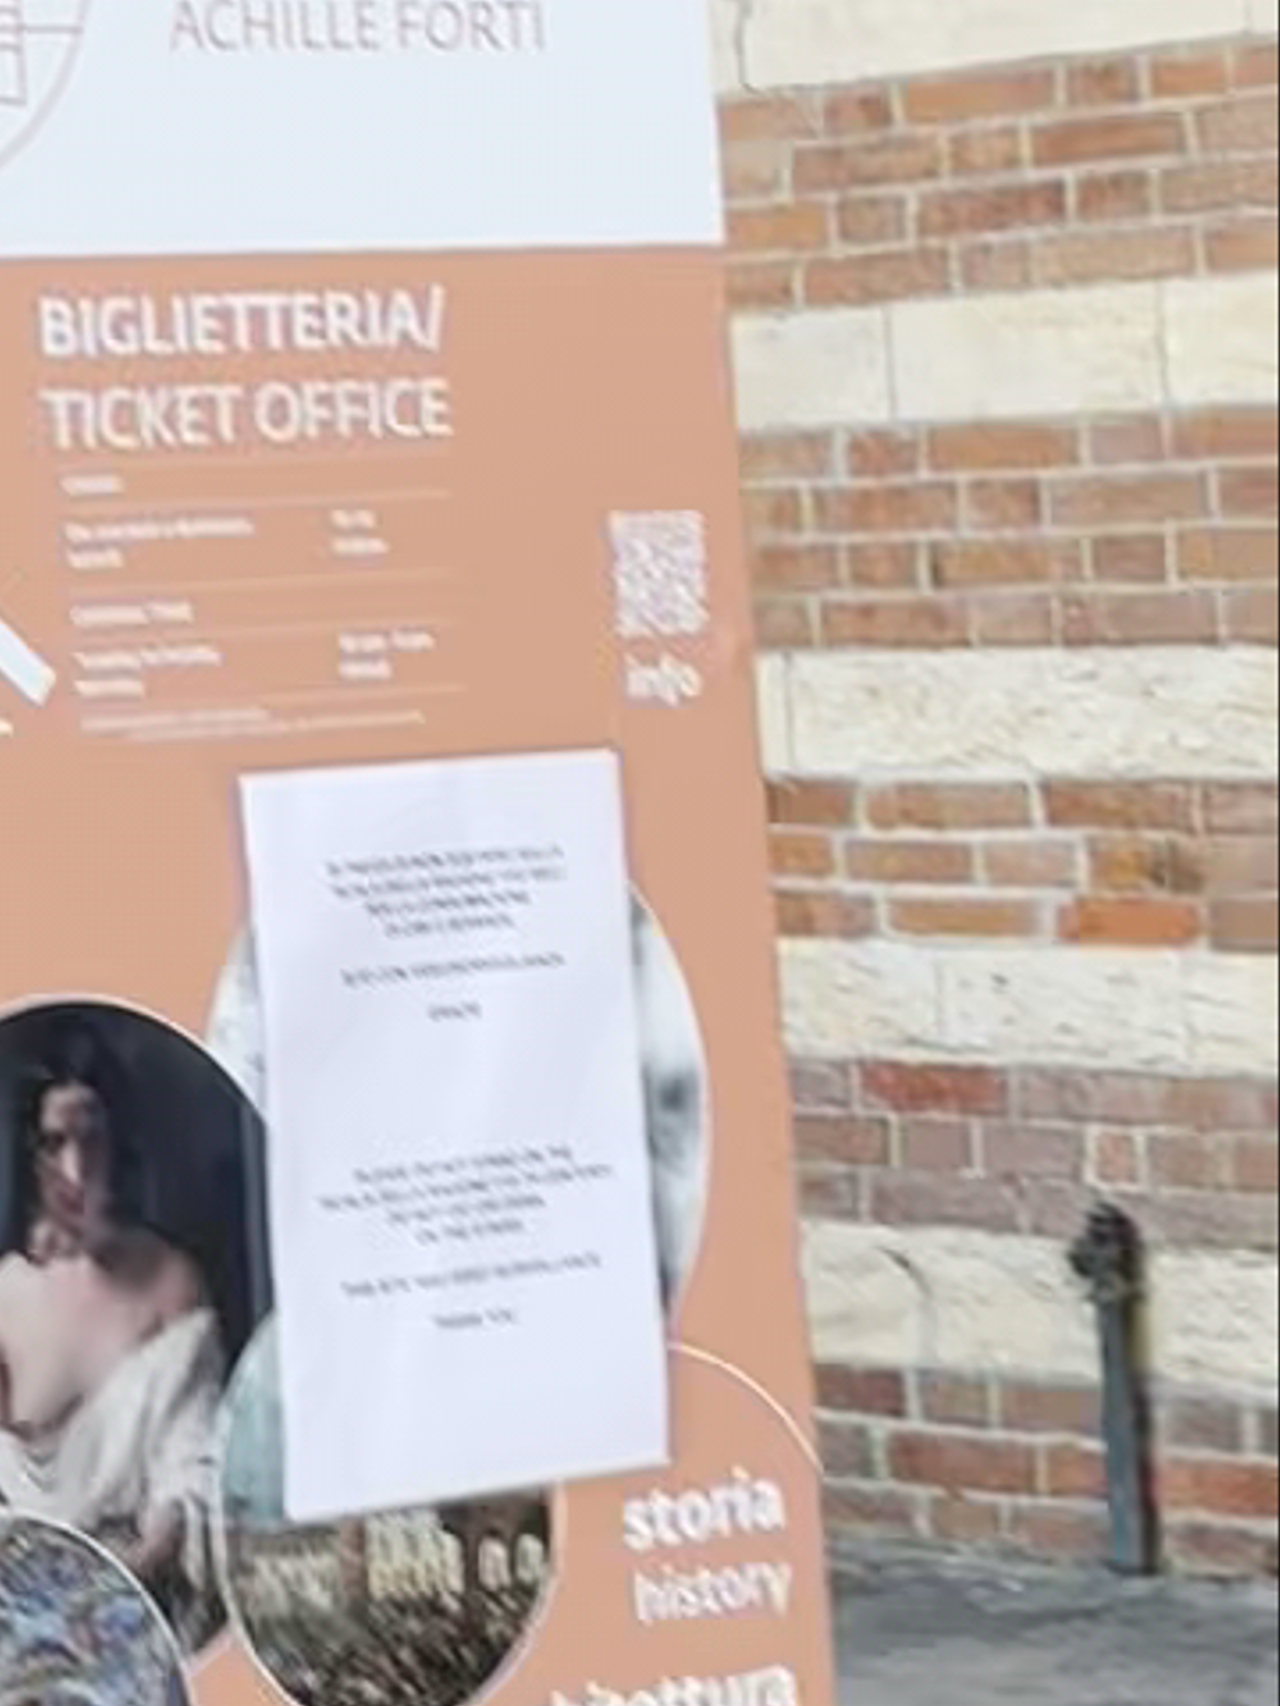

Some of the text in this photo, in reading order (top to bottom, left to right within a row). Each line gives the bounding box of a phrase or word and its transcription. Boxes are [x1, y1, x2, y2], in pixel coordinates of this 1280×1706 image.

[393, 0, 547, 51] FORTI
[40, 283, 446, 357] BIGLIETTERIA/
[39, 378, 454, 450] TICKET OFFICE
[623, 1466, 786, 1552] storia
[634, 1562, 792, 1626] history
